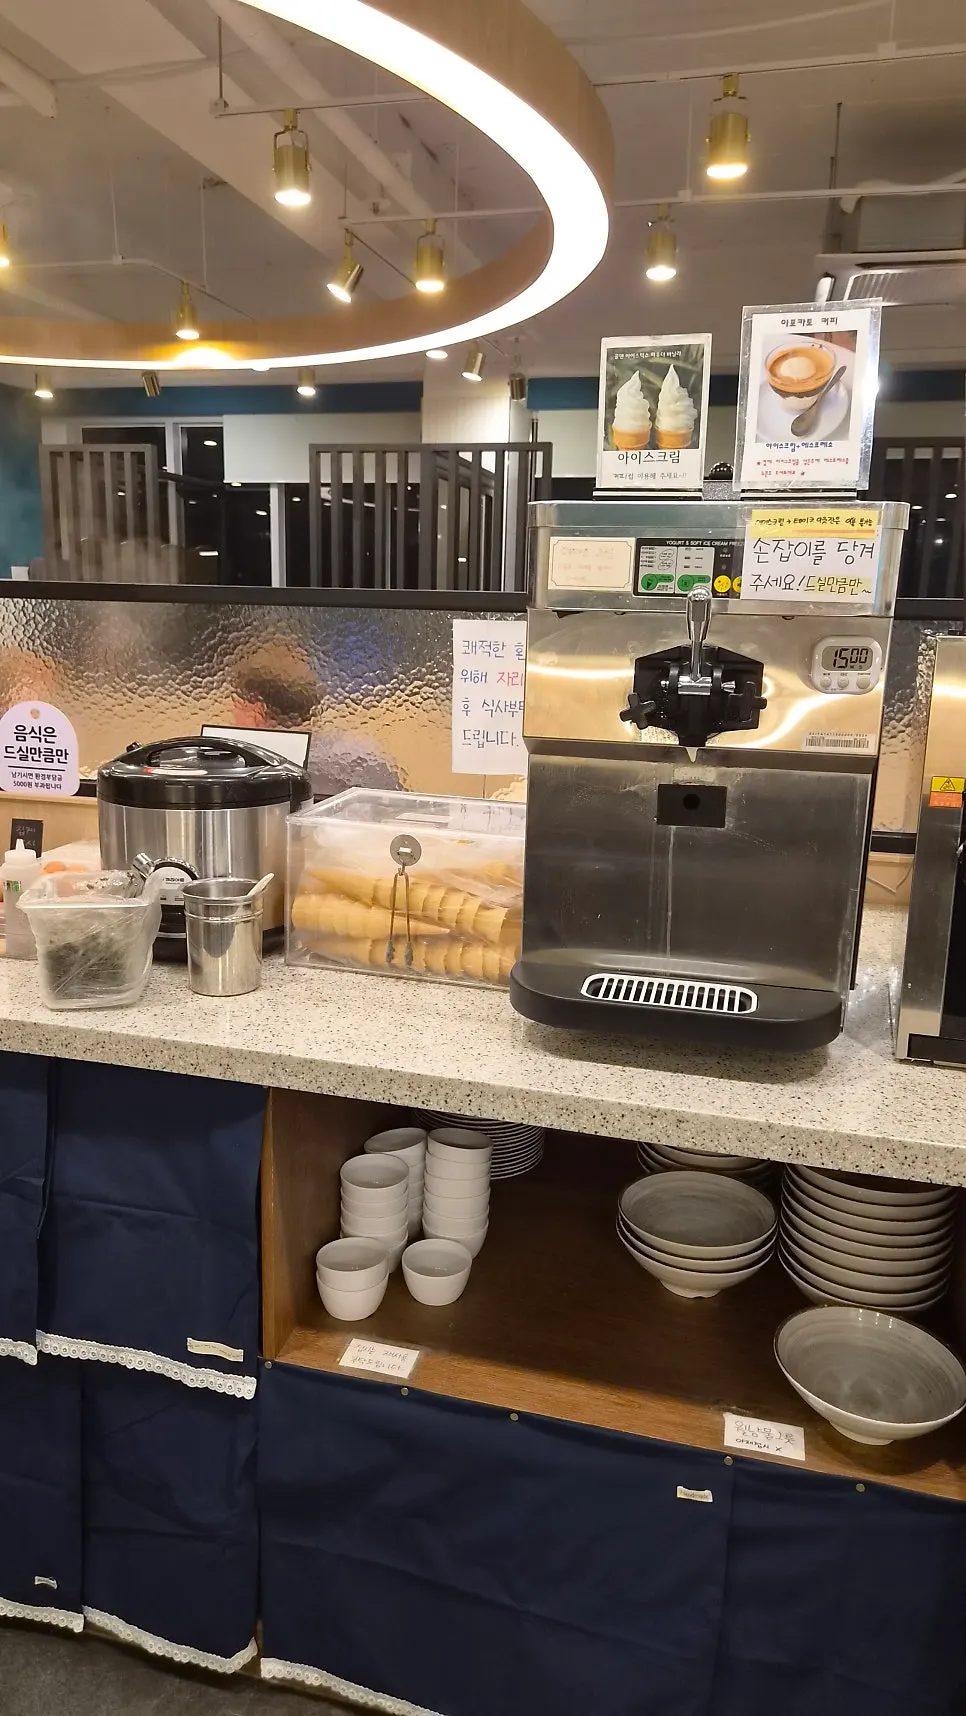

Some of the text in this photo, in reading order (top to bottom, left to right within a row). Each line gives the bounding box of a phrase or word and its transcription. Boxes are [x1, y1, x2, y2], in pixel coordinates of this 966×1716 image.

[821, 316, 838, 326] 커피
[617, 450, 681, 465] 아이스크림
[753, 537, 875, 566] 손잡이를 당겨
[461, 640, 506, 658] 쾌적한
[460, 669, 488, 684] 위해
[461, 698, 471, 716] 후
[14, 724, 57, 744] 음식은
[462, 729, 519, 749] 드립니다.
[3, 745, 70, 765] 드실만큼만
[11, 771, 63, 782] 남기시면 환경부담금
[13, 780, 62, 791] 5000원 부과됩니다
